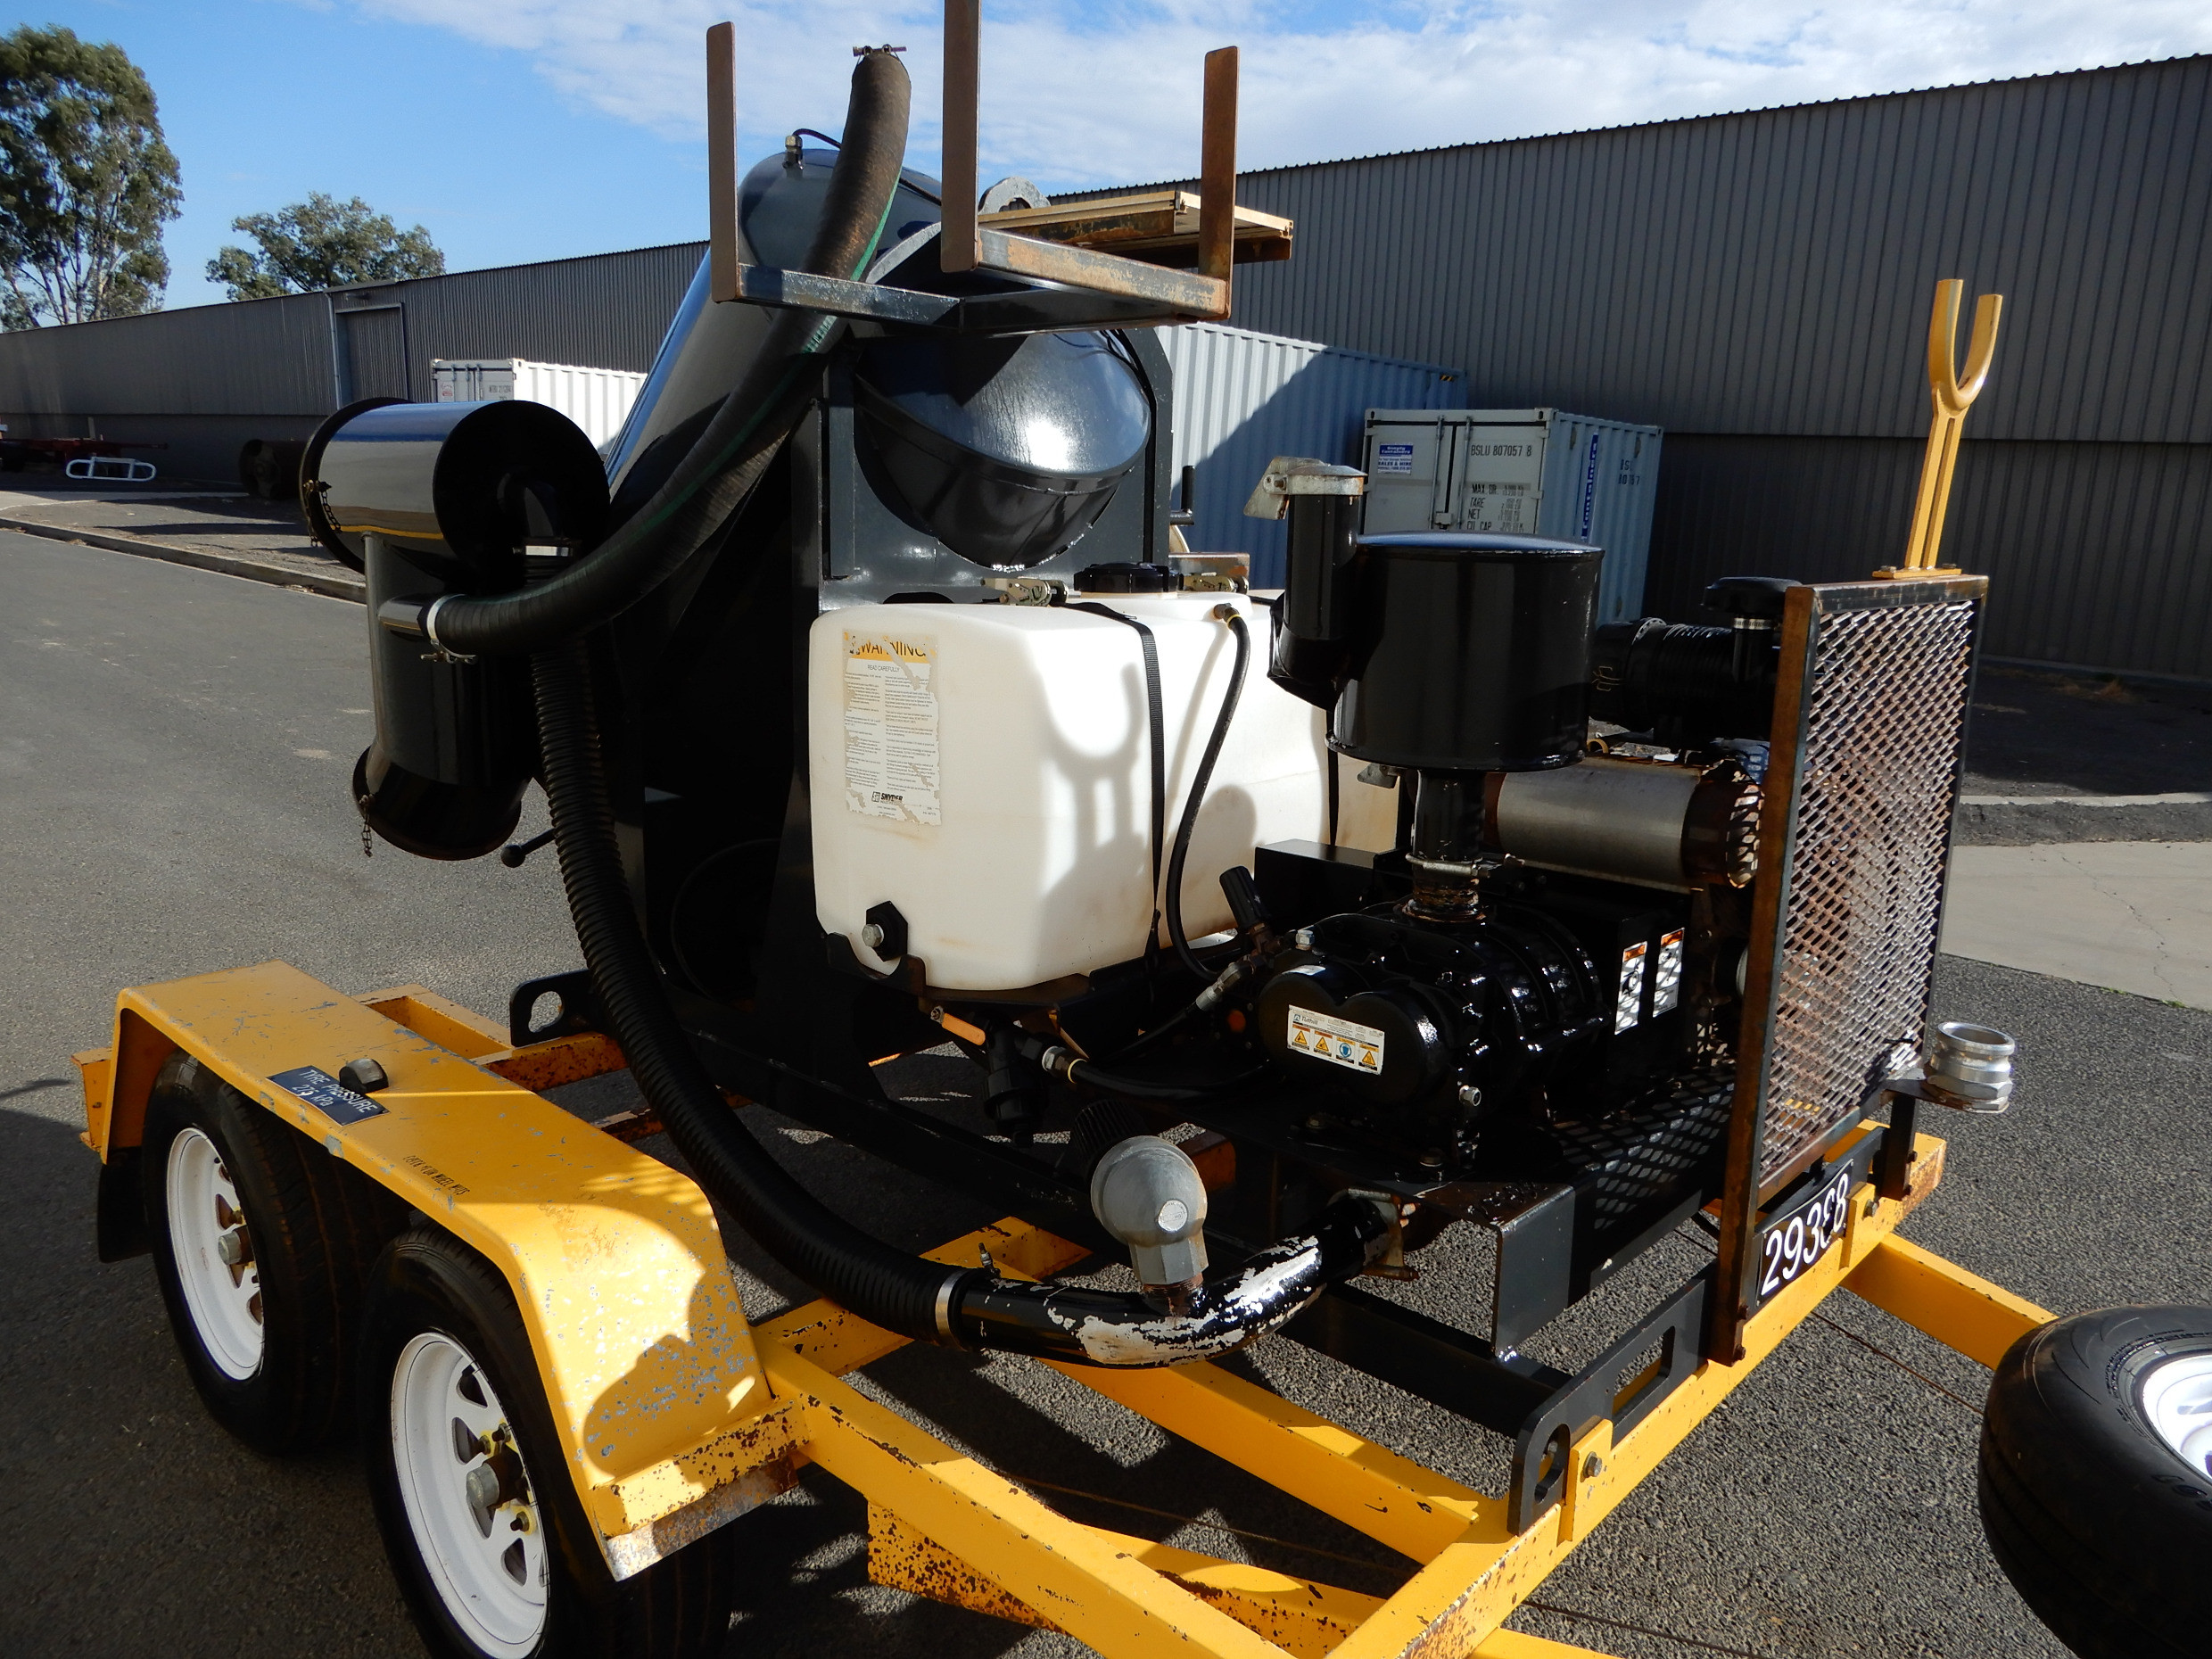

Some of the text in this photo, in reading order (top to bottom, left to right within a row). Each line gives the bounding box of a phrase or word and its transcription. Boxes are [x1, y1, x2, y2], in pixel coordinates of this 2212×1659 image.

[1471, 445, 1532, 457] BSLU 807057 8
[1472, 483, 1485, 493] MAX
[1470, 497, 1485, 508] TARE
[1467, 508, 1481, 519] NET
[860, 640, 927, 657] WANING
[292, 1084, 334, 1107] 275 kPa
[299, 1069, 378, 1113] TYRE PRESSURE
